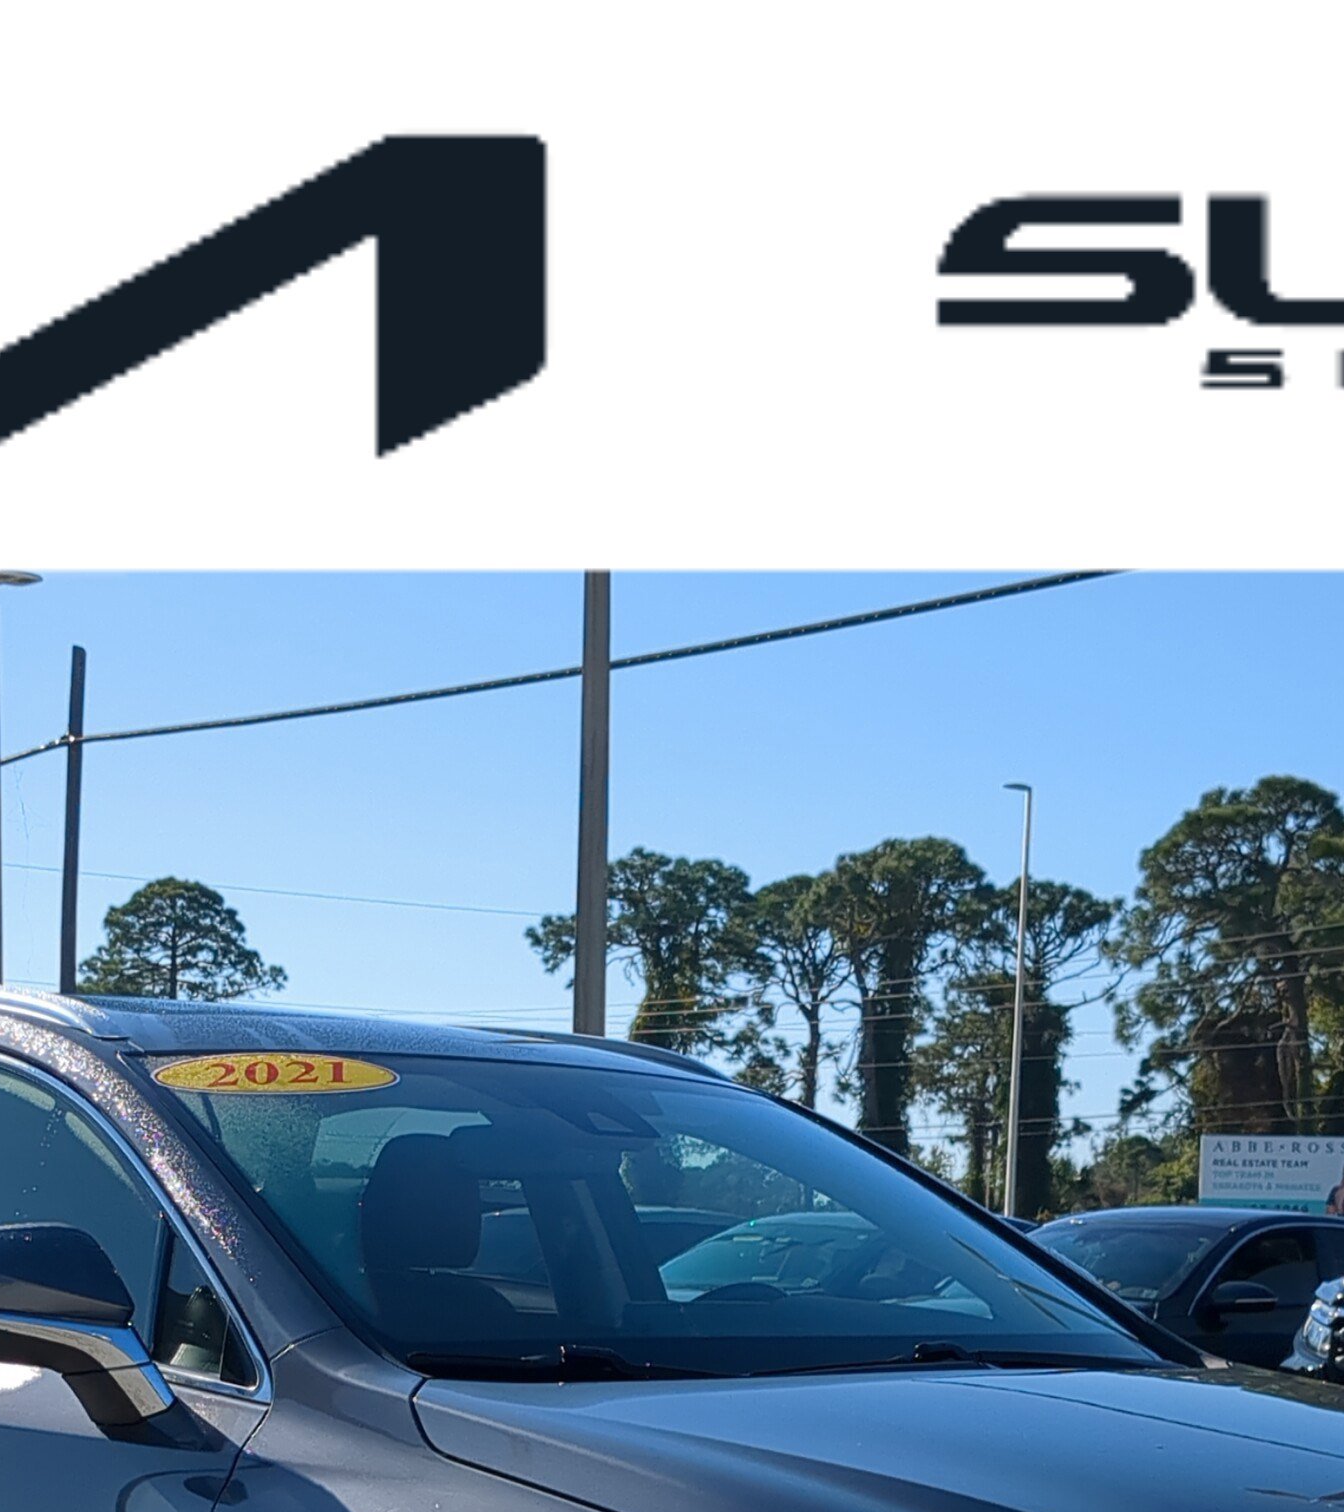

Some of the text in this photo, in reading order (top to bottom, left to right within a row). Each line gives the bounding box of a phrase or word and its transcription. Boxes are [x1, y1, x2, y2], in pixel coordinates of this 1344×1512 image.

[207, 1060, 353, 1088] 2021
[1212, 1158, 1309, 1169] REAL ESTATE TEAM
